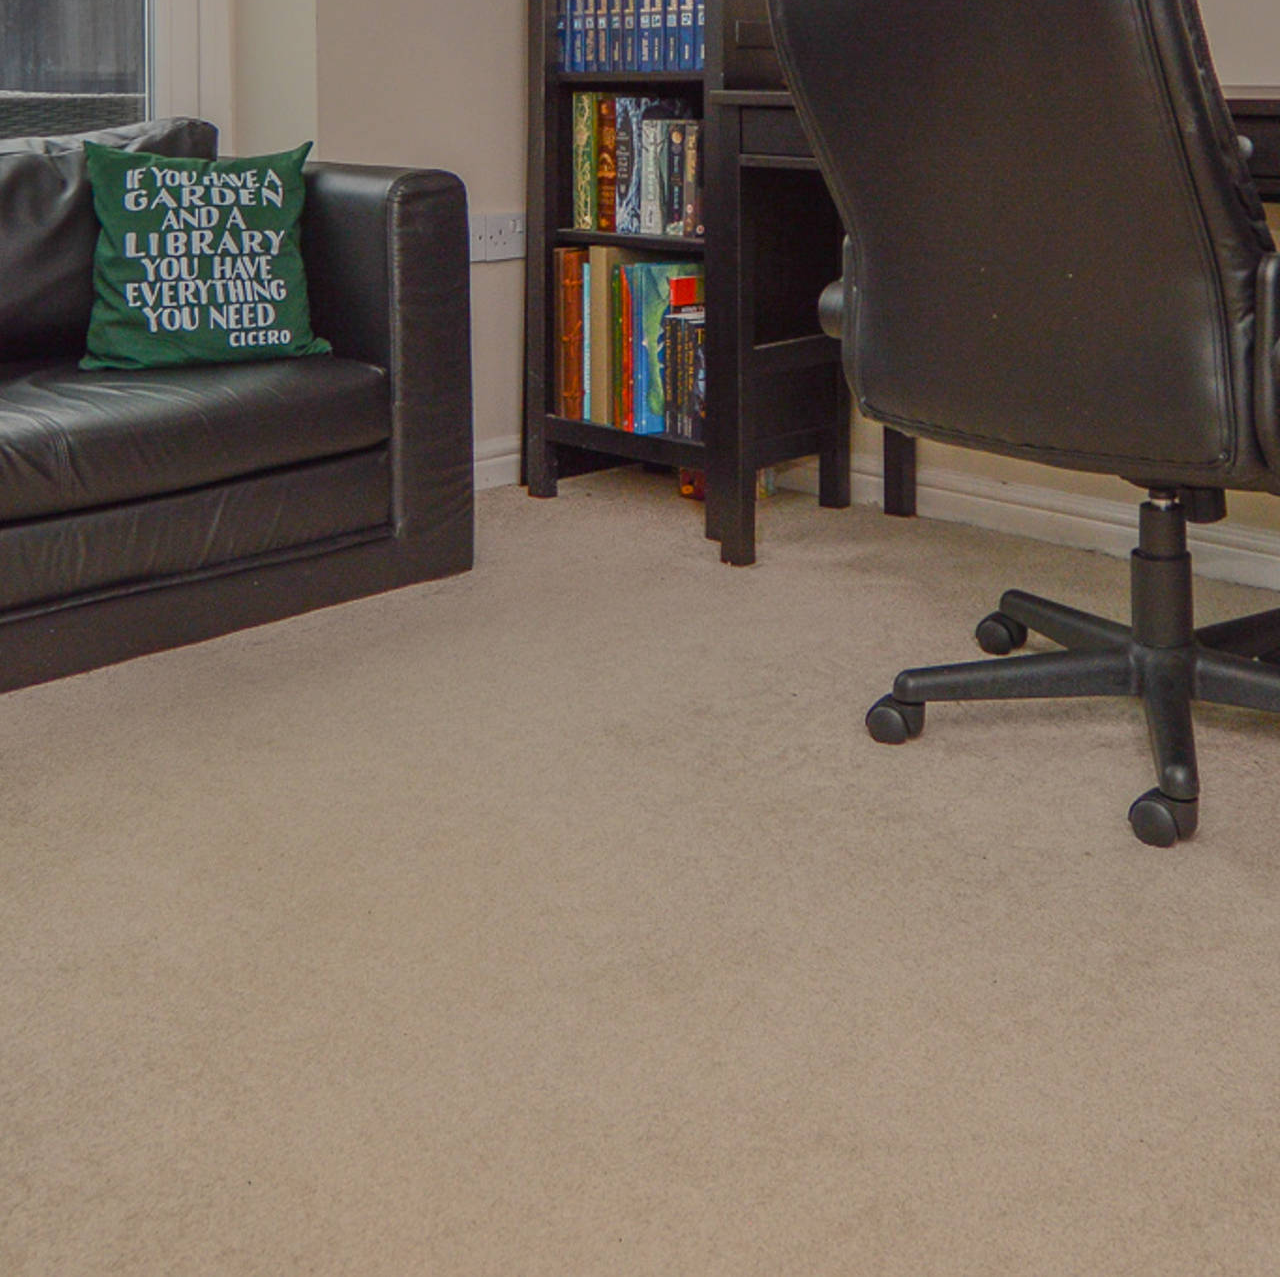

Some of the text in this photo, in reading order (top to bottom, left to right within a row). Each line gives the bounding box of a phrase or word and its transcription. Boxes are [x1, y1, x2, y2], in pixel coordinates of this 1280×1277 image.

[125, 166, 283, 189] IF YOU HAVE A
[124, 185, 284, 211] GARDEN
[161, 206, 247, 231] AND A
[124, 229, 286, 258] LIBRARY
[141, 255, 273, 282] YOU HAVE
[125, 279, 288, 307] EVERYTHING
[142, 303, 276, 333] YOU NEED
[229, 329, 291, 347] CICERO
